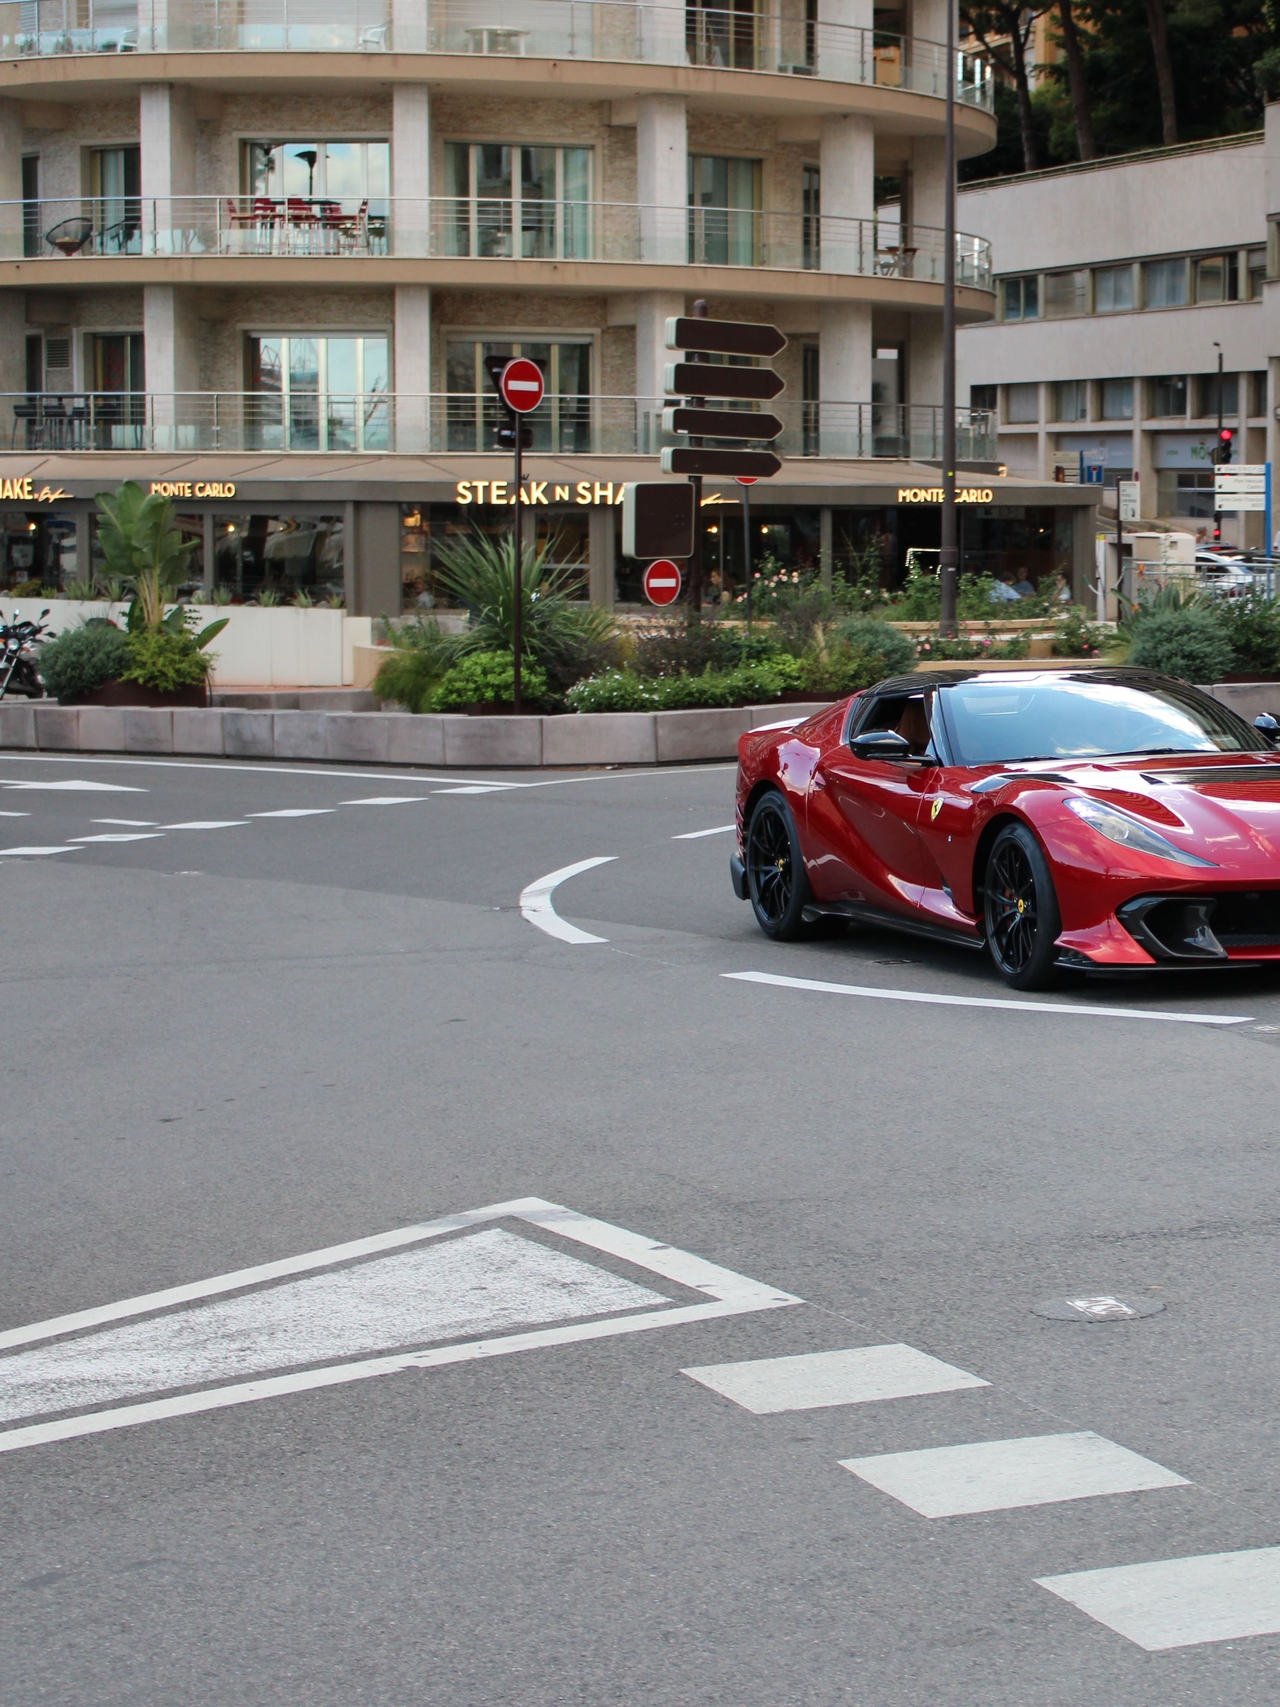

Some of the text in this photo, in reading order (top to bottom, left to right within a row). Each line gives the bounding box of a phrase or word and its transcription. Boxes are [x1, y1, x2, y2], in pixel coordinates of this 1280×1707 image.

[0, 478, 33, 499] AKE
[151, 482, 235, 498] MONTE CARLO
[456, 481, 549, 505] STEAK
[897, 488, 945, 503] MONTE
